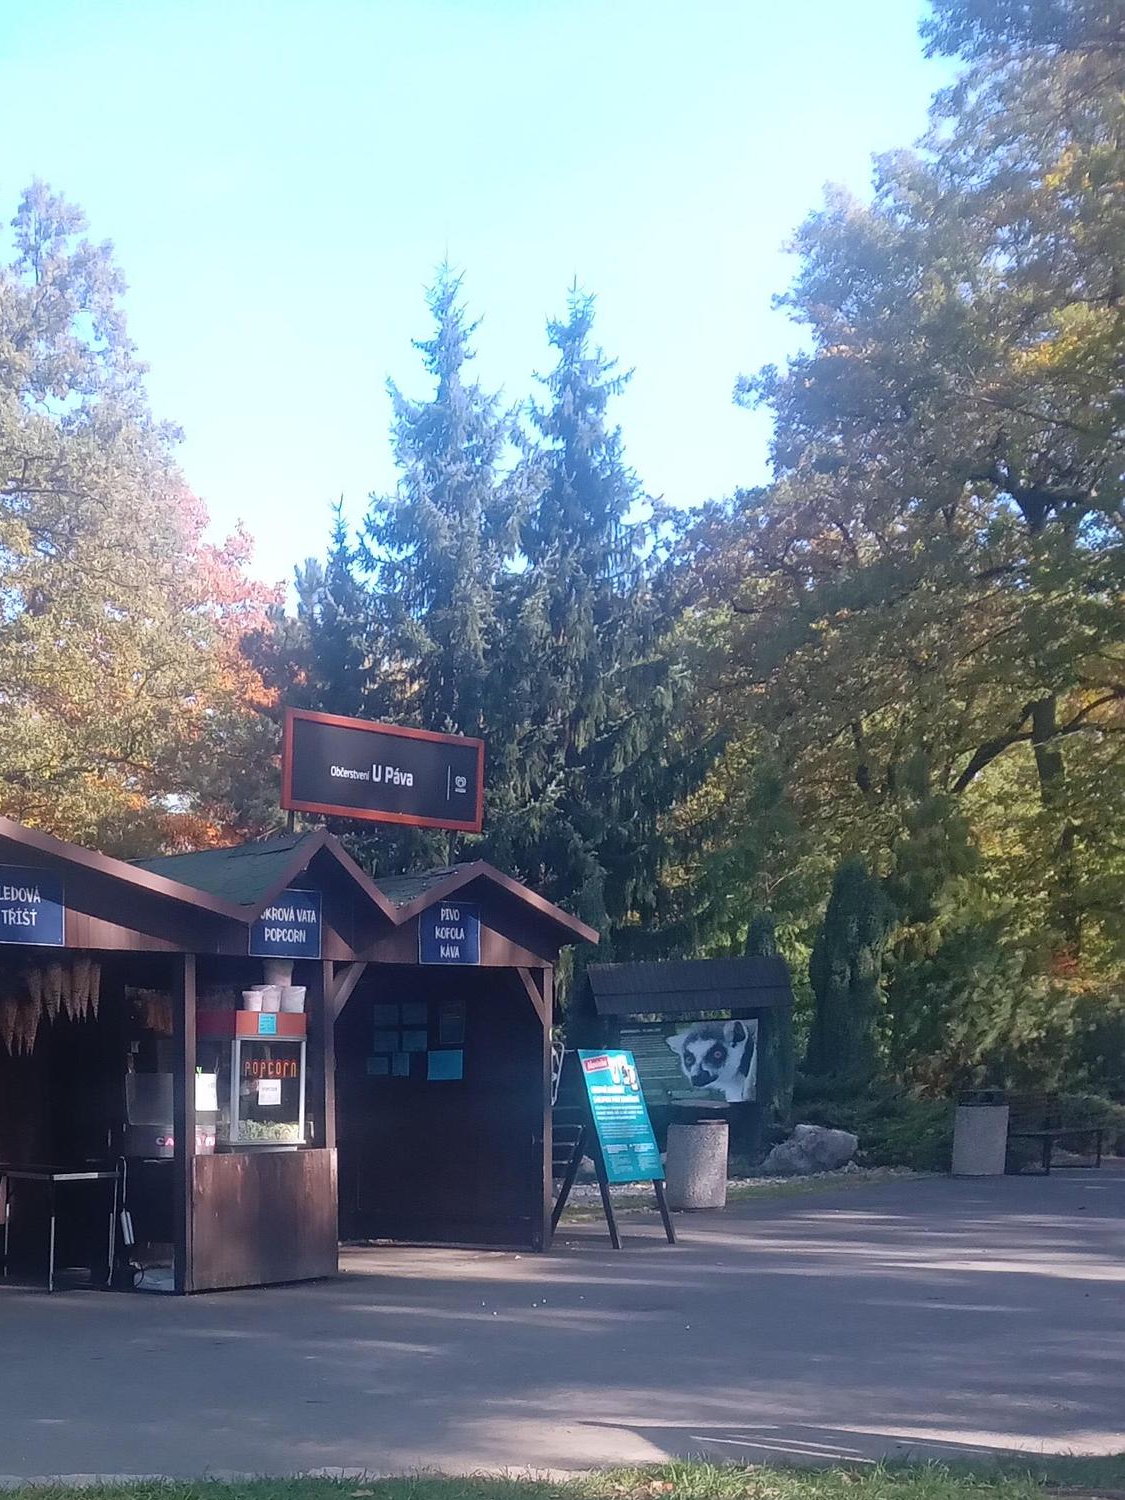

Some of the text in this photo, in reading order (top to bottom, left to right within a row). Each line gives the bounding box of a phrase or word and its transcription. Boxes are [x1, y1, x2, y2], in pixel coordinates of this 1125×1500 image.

[330, 764, 413, 787] Občerstvení U Páva
[296, 908, 317, 923] VATA
[440, 908, 460, 921] PIVO
[264, 927, 306, 943] POPCORN
[435, 926, 465, 940] KOFOLA
[439, 944, 460, 959] KÁVA
